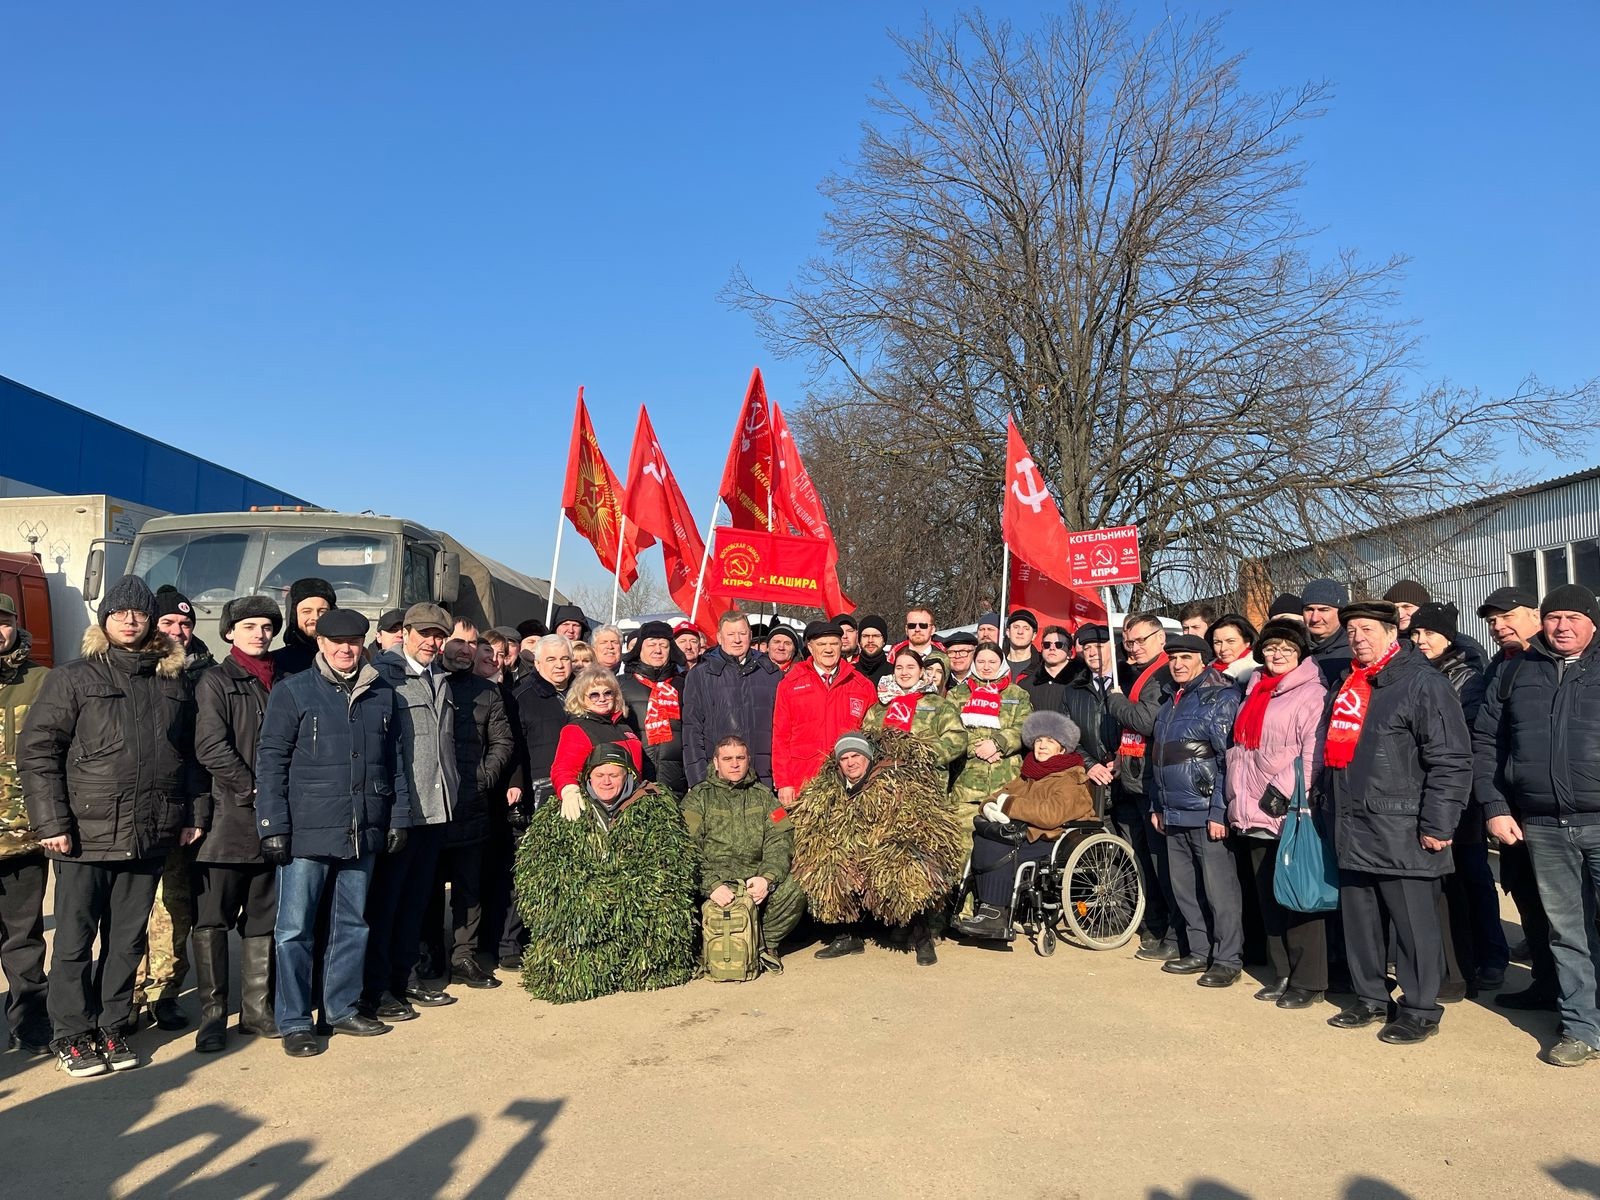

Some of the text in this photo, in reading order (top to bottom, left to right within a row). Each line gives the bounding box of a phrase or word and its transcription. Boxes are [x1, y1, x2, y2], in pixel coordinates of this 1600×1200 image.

[1069, 528, 1135, 545] КОТЕЛЬНИКИ
[720, 543, 746, 559] МОСКОВСКАЯ
[1122, 547, 1135, 555] ЗА
[1074, 553, 1085, 561] ЗА
[1090, 565, 1119, 577] КПРФ
[722, 577, 753, 587] КПРФ
[759, 575, 817, 590] г. КАШИРА
[1072, 578, 1084, 586] ЗА
[971, 698, 999, 709] КПРФ
[645, 719, 669, 730] КПРФ
[1331, 719, 1360, 731] КПРФ
